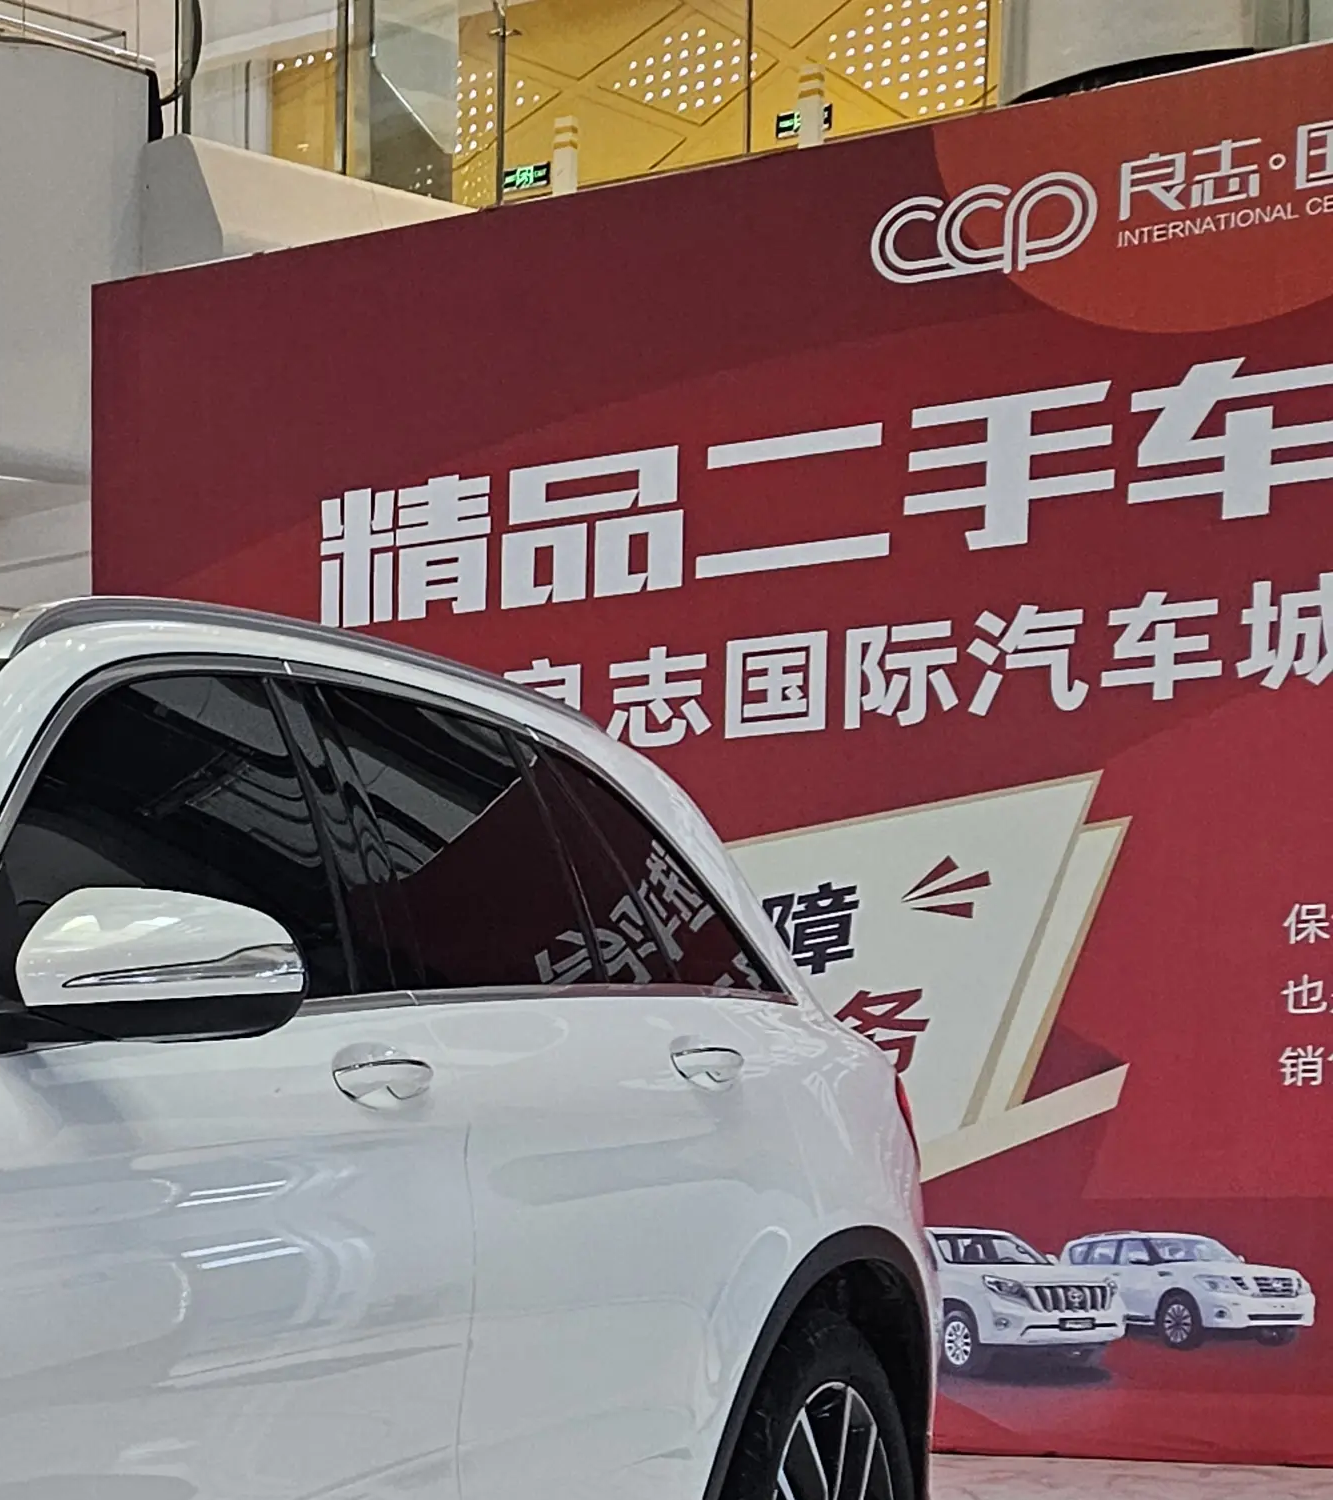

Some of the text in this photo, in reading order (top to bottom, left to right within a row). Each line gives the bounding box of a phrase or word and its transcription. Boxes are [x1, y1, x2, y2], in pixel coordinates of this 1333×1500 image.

[1116, 202, 1300, 249] INTERNATIONAL
[319, 355, 1333, 628] 精品二手车
[762, 882, 861, 976] 障
[1282, 902, 1333, 945] 保
[1280, 973, 1333, 1015] 也
[1278, 1044, 1333, 1087] 销
